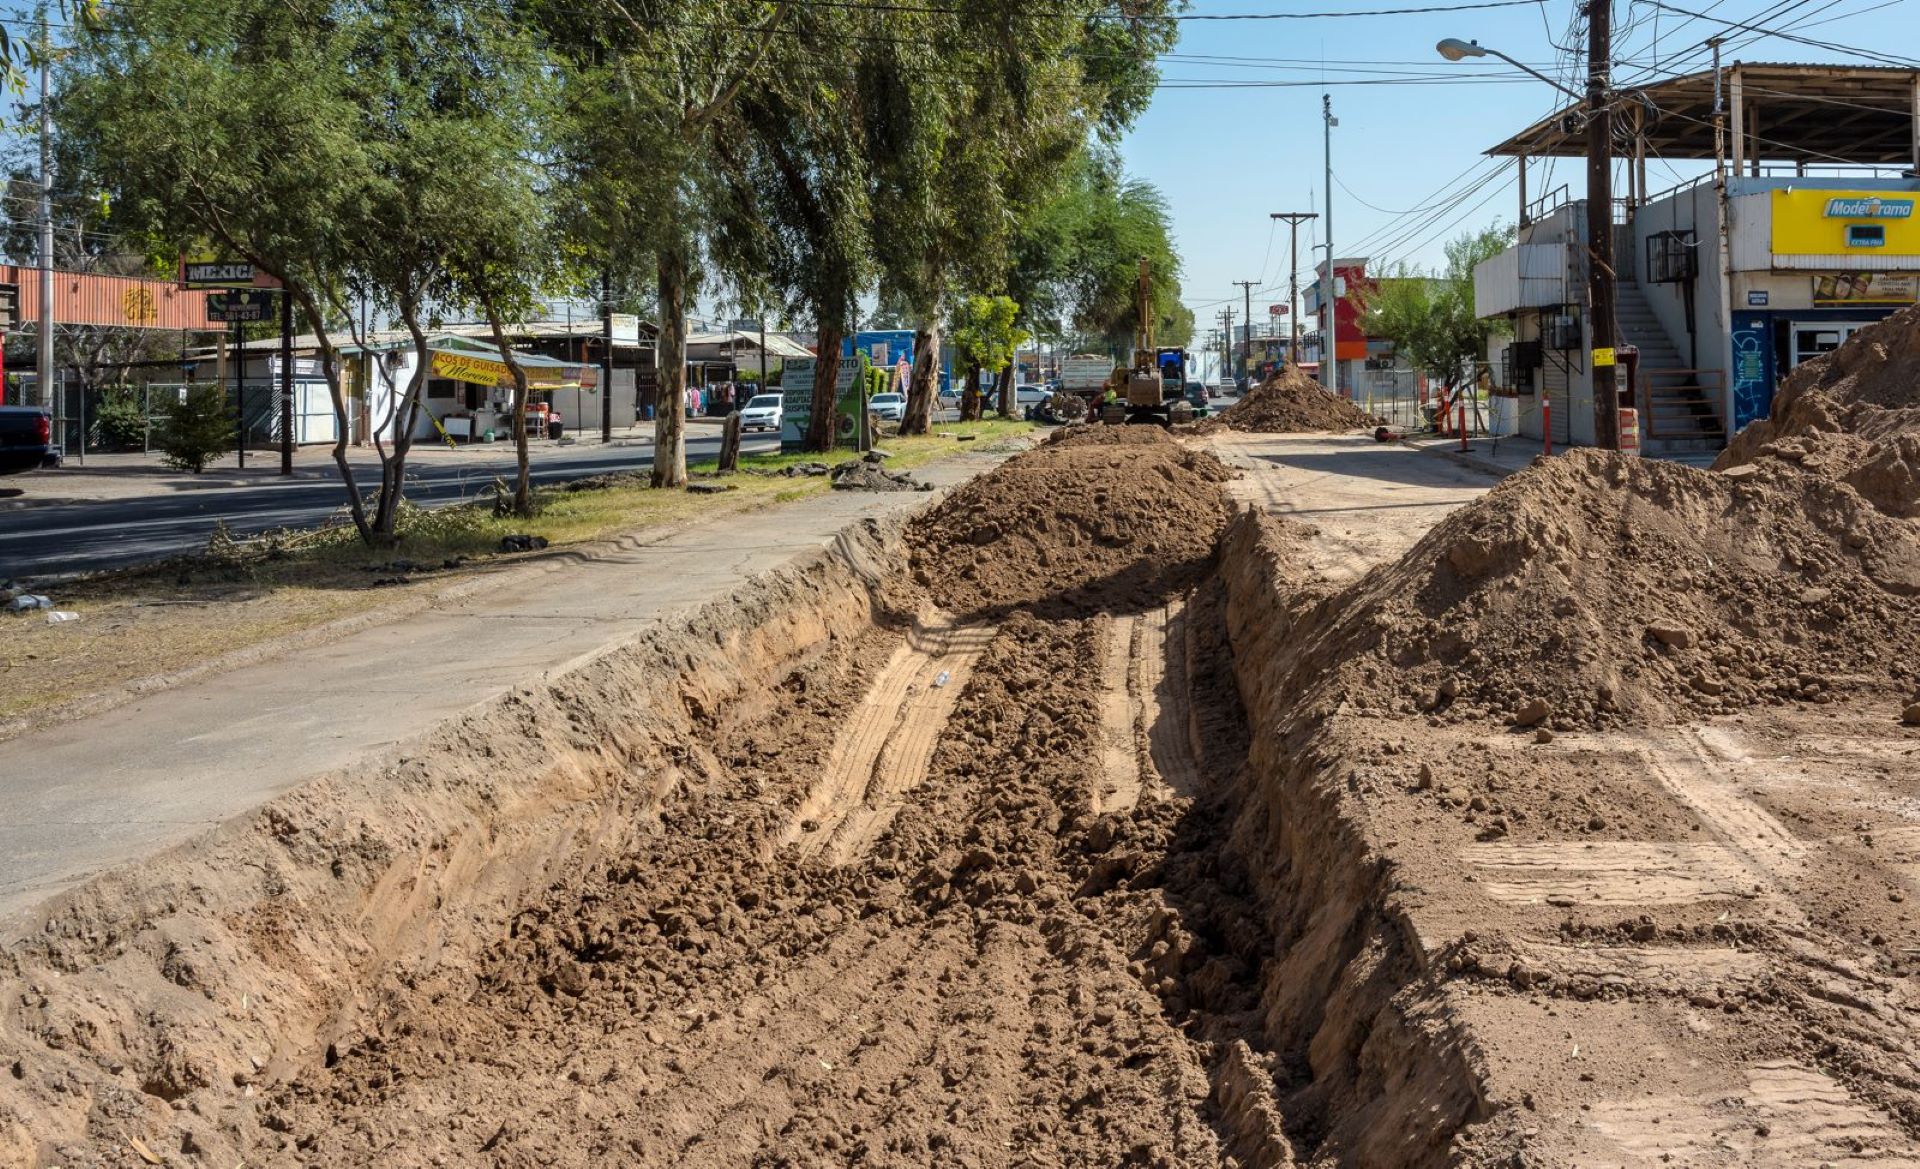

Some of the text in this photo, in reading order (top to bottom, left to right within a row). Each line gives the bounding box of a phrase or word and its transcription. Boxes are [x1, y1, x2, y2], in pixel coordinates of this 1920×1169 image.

[1830, 200, 1911, 216] Modelorama
[433, 353, 458, 366] ACOS
[460, 357, 471, 368] DE
